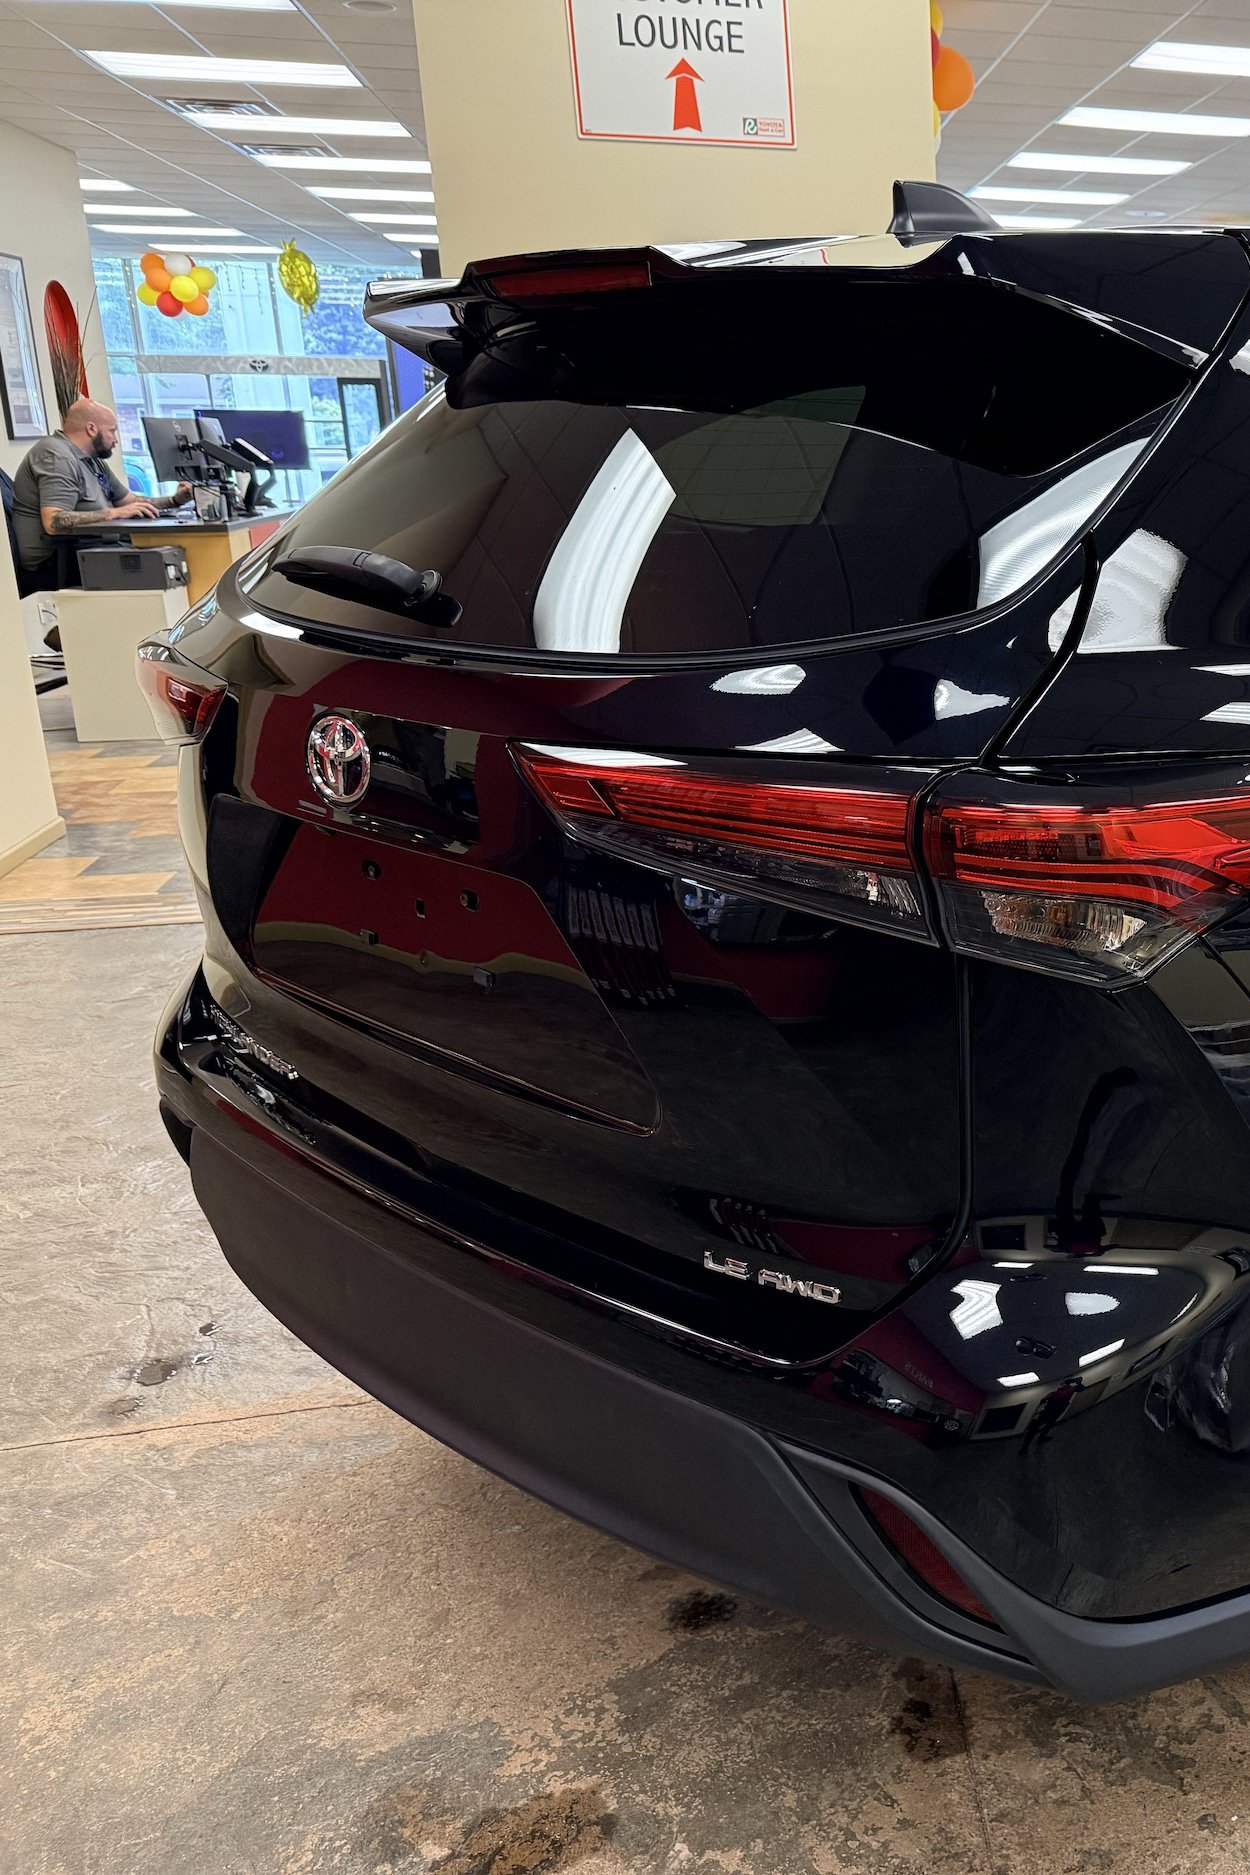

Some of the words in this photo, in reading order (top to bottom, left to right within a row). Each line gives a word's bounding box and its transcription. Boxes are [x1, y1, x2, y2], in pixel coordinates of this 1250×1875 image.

[617, 13, 745, 54] LOUNGE
[704, 1250, 750, 1280] LE
[758, 1269, 843, 1304] AWD
